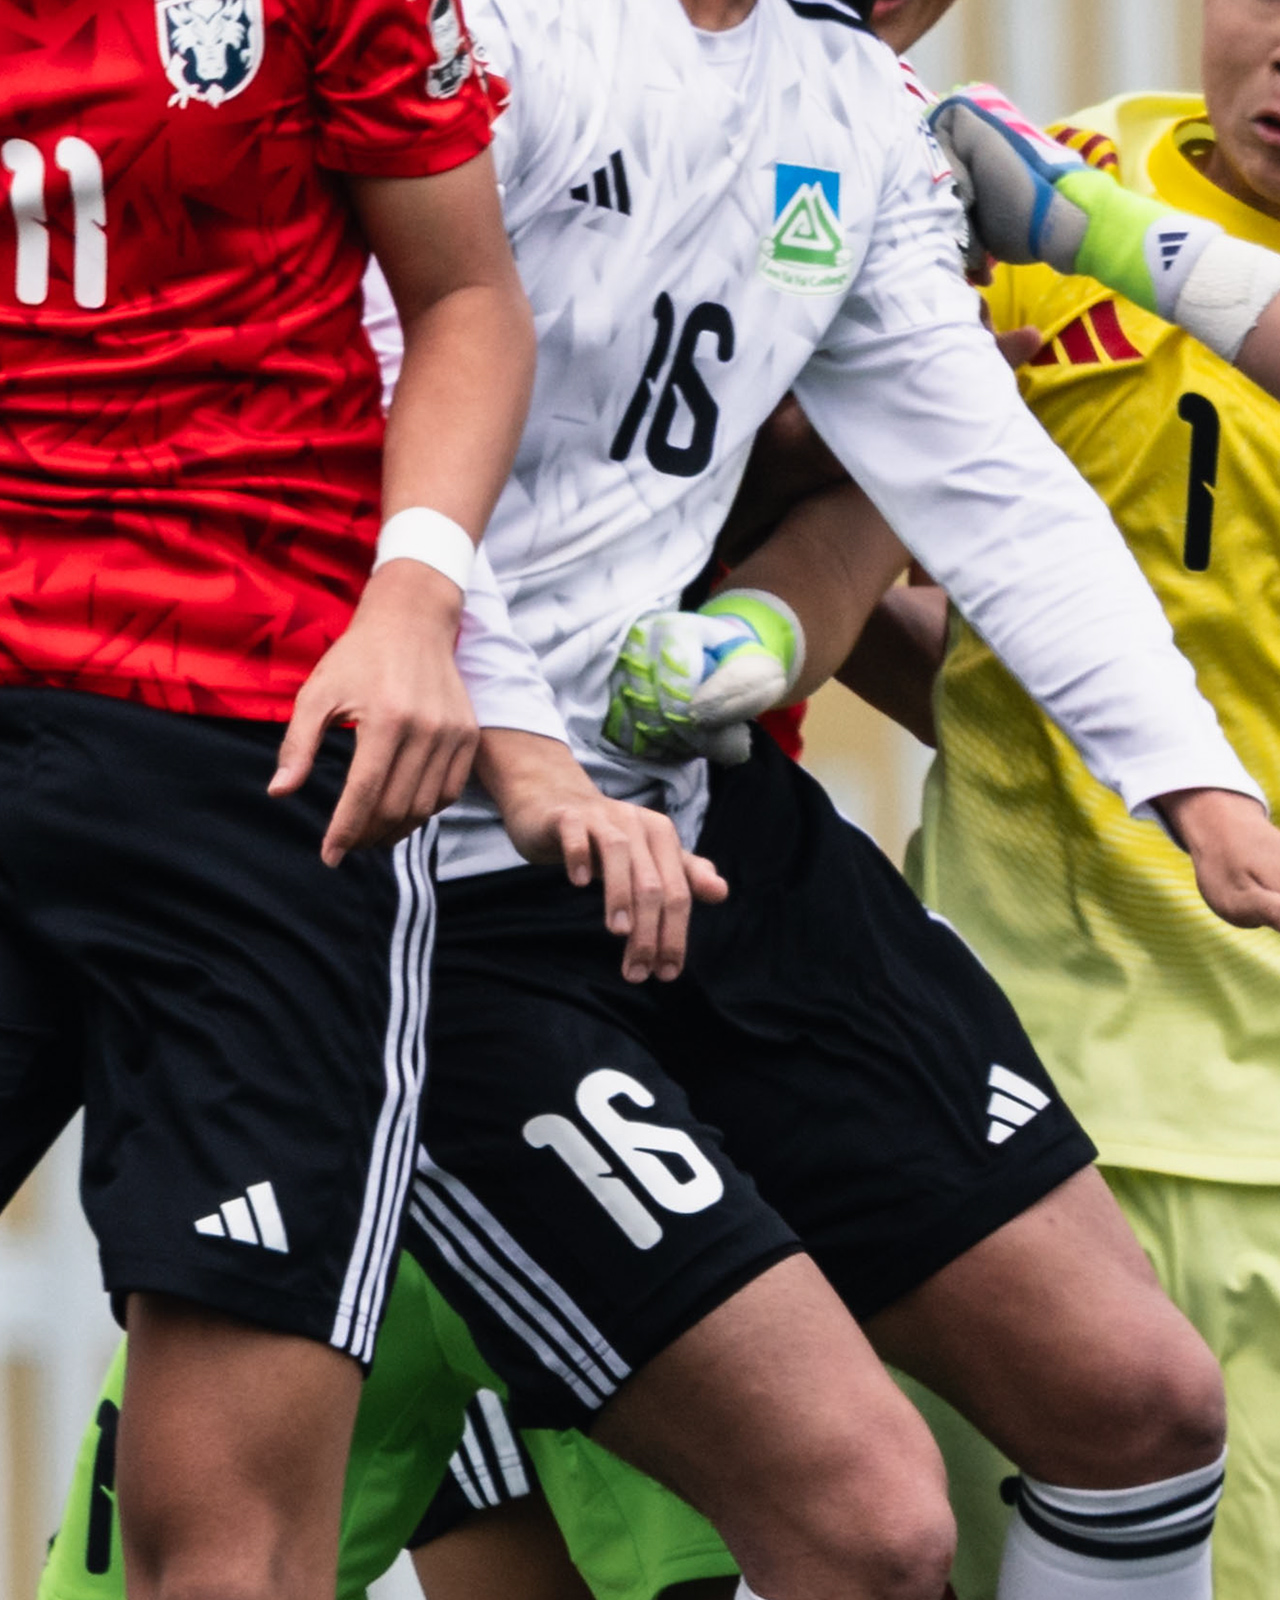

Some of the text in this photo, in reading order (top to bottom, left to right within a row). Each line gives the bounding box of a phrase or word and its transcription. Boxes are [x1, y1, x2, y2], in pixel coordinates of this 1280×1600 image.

[1, 136, 107, 309] 11
[609, 291, 735, 477] 16
[1177, 392, 1220, 572] 1
[523, 1069, 724, 1250] 16
